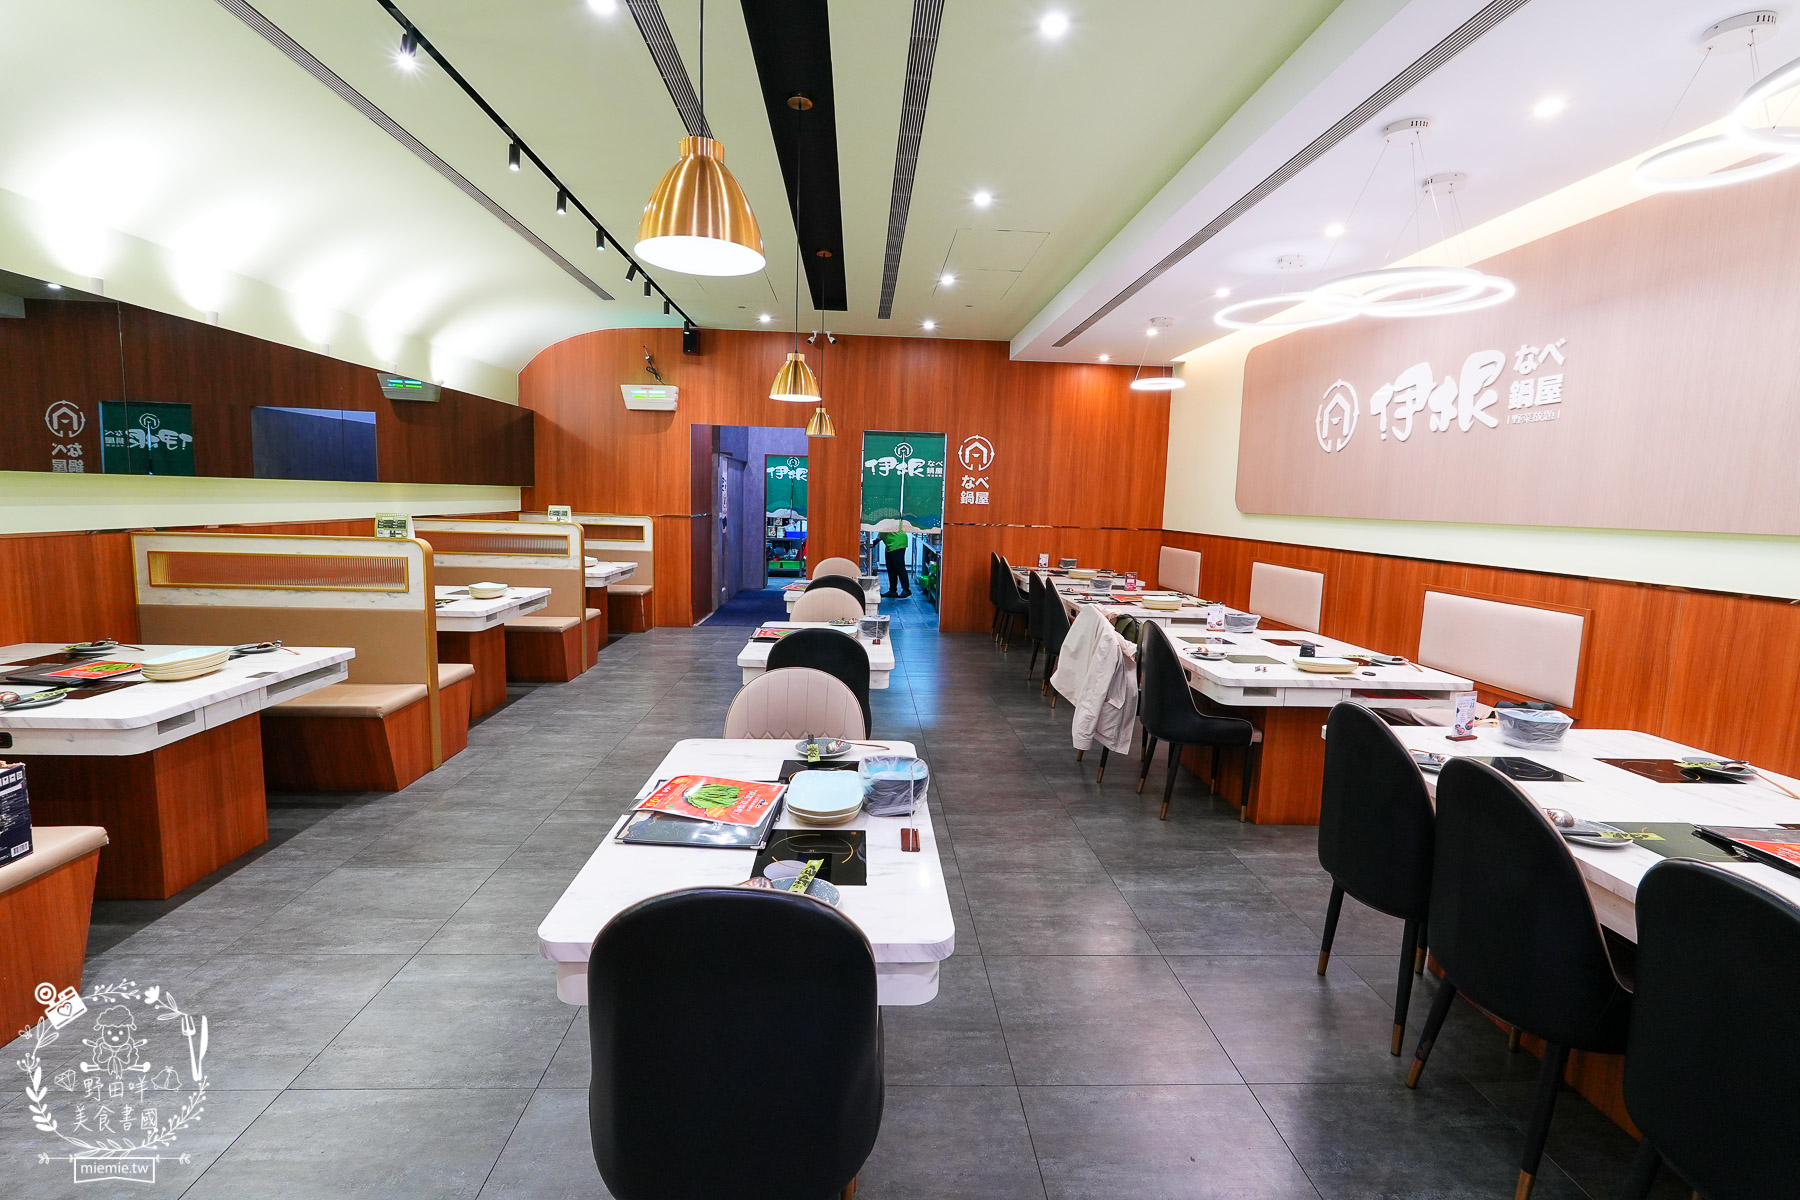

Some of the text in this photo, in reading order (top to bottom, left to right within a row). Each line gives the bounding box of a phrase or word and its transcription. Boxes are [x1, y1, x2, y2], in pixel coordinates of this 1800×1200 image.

[1514, 337, 1567, 375] なべ
[1369, 349, 1507, 442] 伊根
[1508, 374, 1564, 410] 鍋屋
[864, 456, 926, 477] 伊根
[961, 475, 989, 490] なべ
[960, 491, 990, 505] 鍋屋
